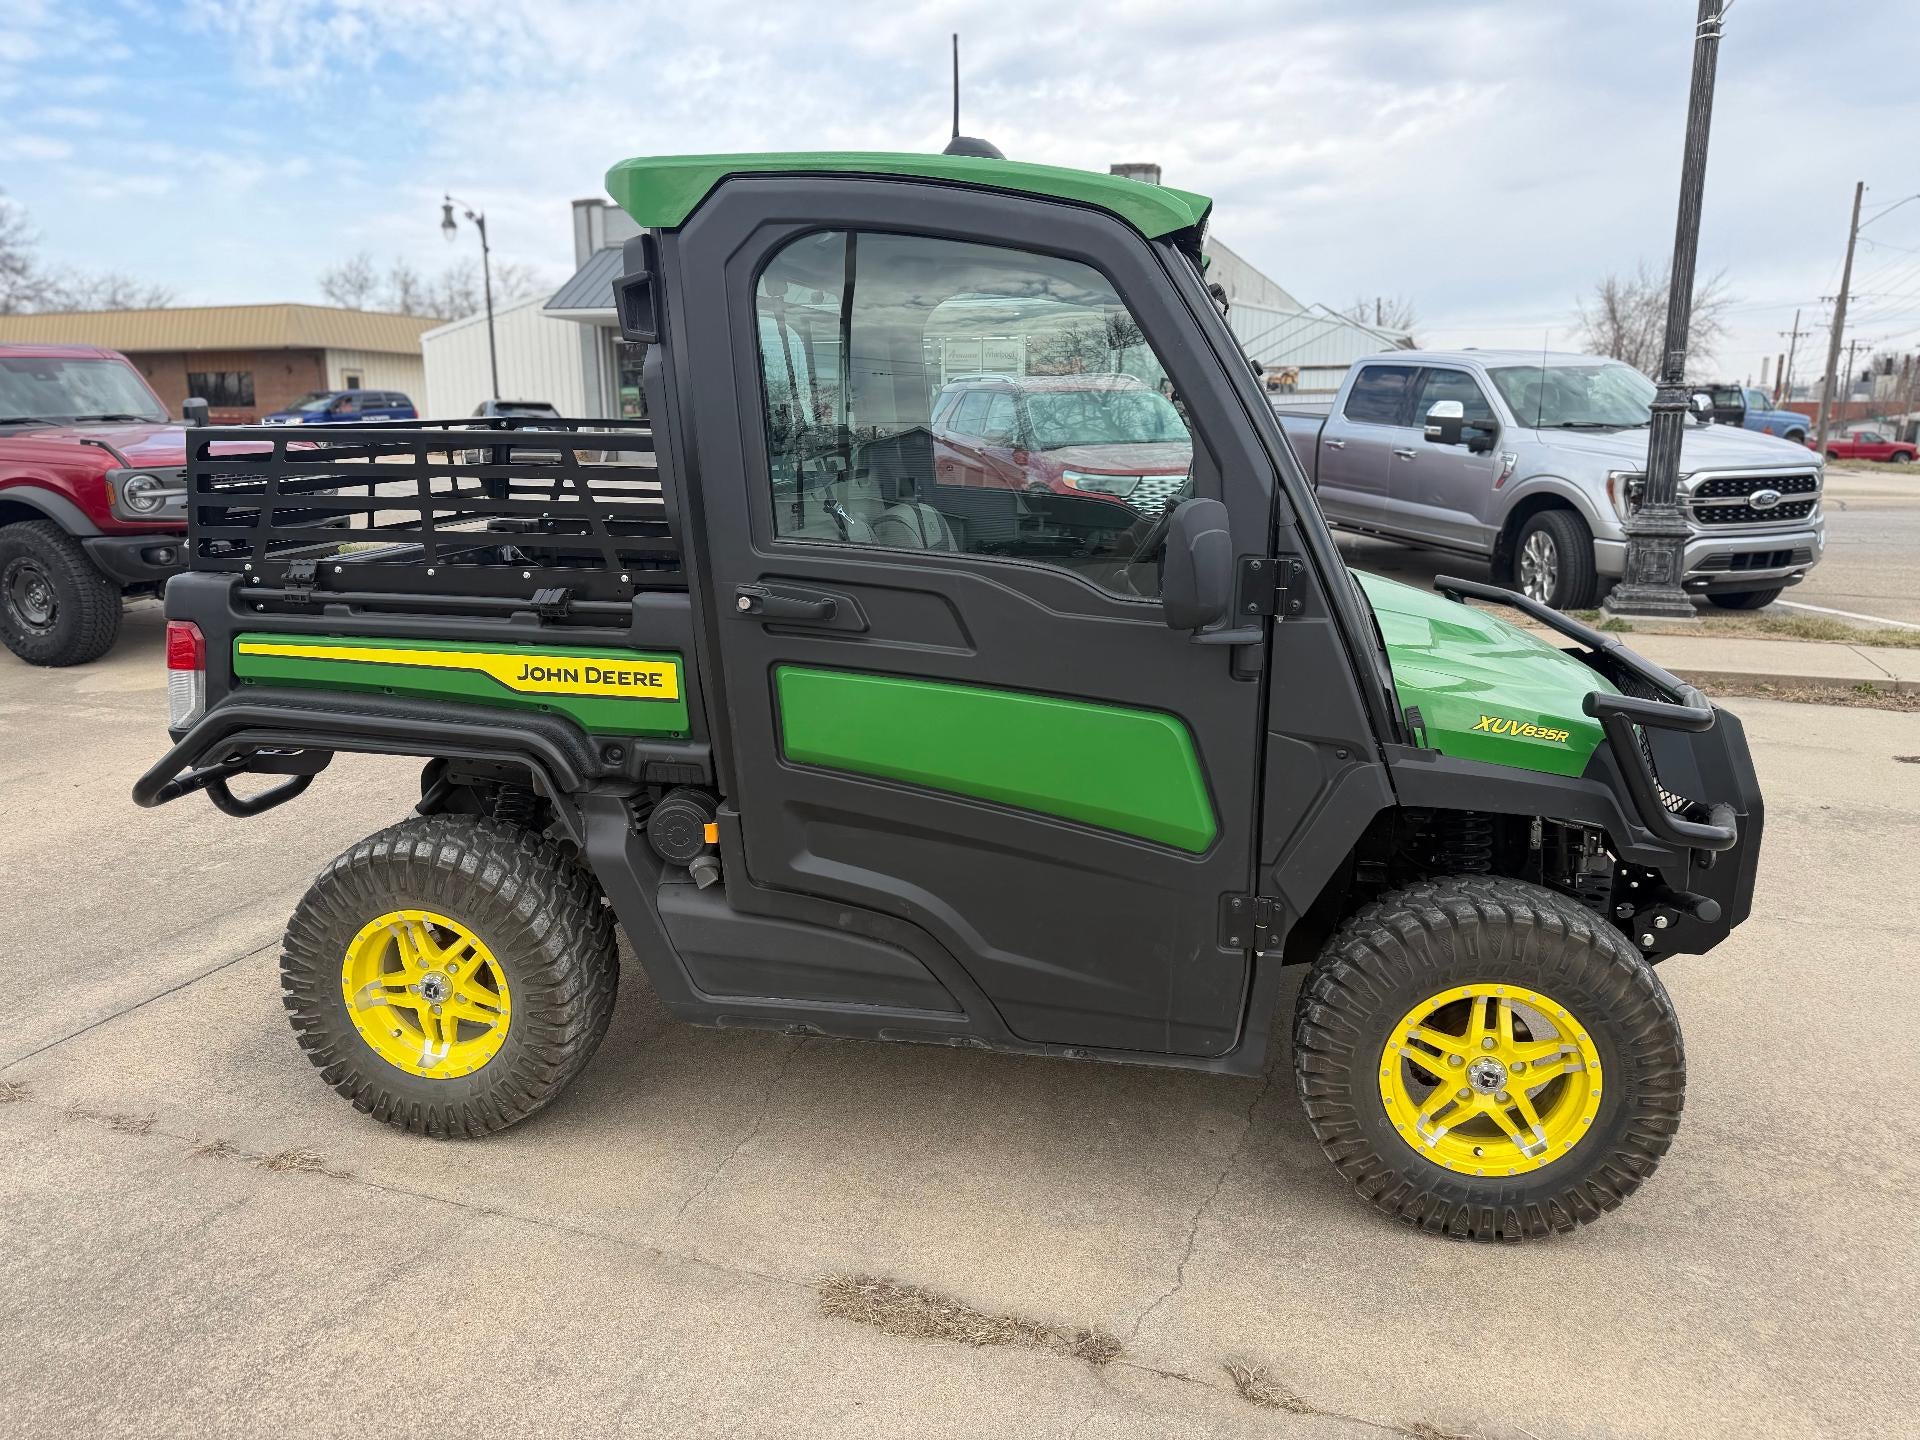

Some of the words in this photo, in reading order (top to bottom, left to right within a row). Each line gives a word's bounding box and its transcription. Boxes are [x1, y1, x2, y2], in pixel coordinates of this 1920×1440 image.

[516, 663, 579, 683] JOHN
[585, 666, 663, 688] DEERE
[1471, 715, 1570, 743] XUV835R
